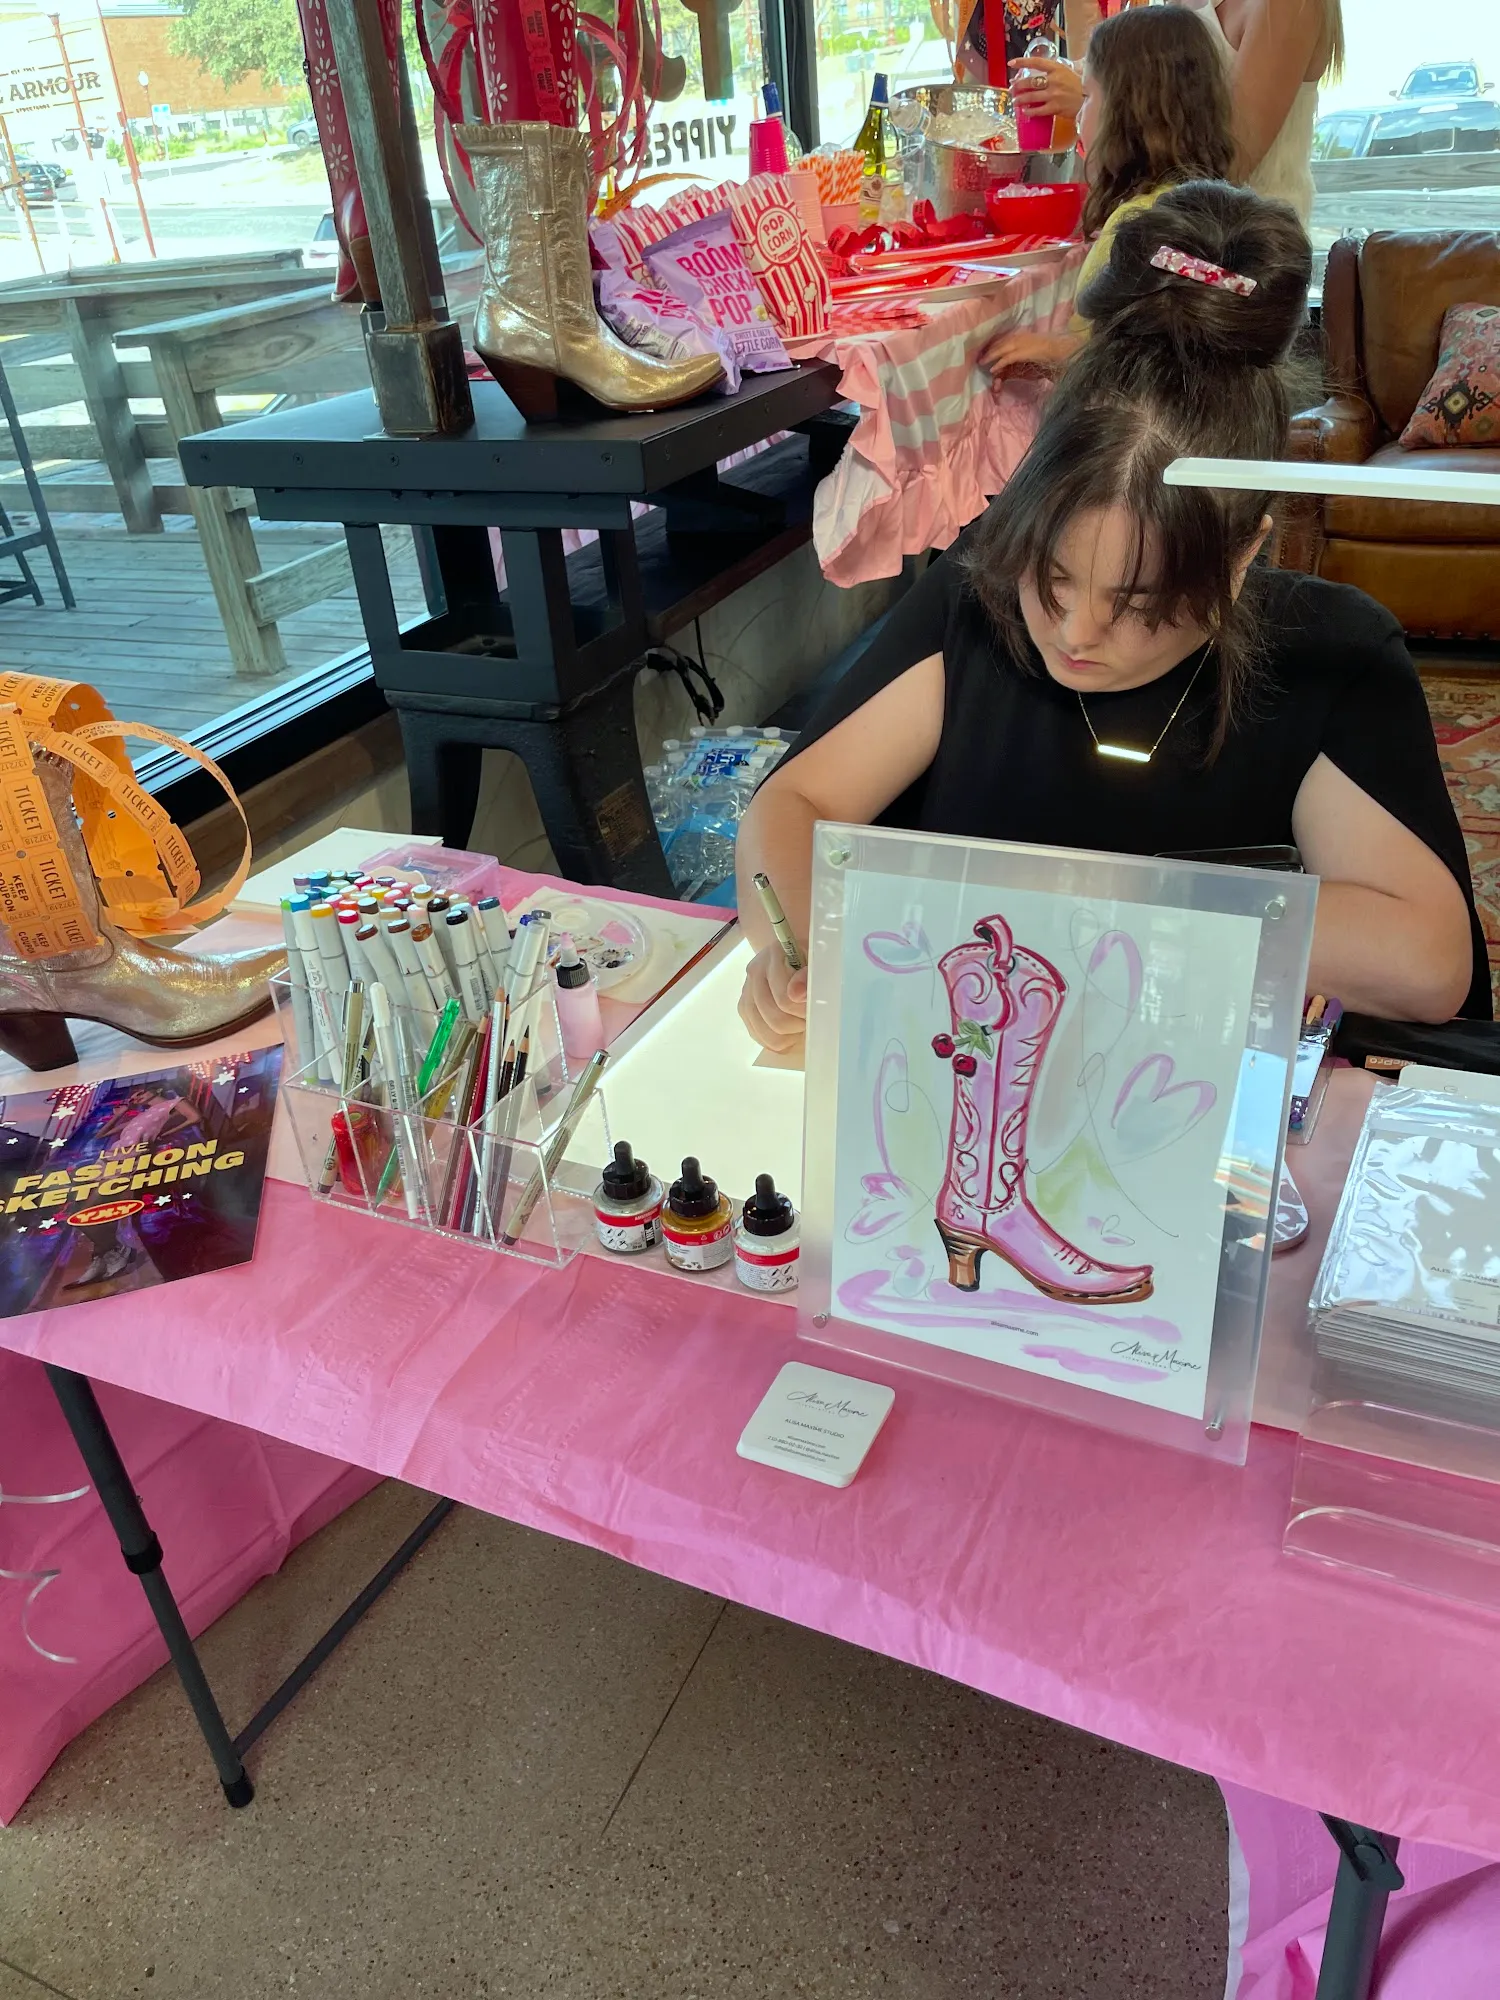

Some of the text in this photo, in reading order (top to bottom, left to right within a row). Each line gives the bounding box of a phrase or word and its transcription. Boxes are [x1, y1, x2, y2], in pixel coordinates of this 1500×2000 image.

[9, 71, 101, 102] ARMOUR
[762, 214, 786, 234] POP
[766, 227, 796, 252] CORN
[676, 242, 746, 279] BOOM
[698, 269, 757, 297] CHICKA
[708, 293, 753, 329] POP
[733, 336, 781, 354] ETTLE CORN
[42, 682, 64, 708] COUPO
[61, 739, 103, 770] TICKET
[14, 785, 43, 831] TICKET
[121, 784, 156, 820] TICKET
[24, 832, 53, 845] 137218
[165, 834, 186, 869] TICKET
[8, 882, 18, 899] THIS
[12, 874, 29, 901] KEEP
[39, 858, 67, 900] TICKET
[35, 932, 50, 948] KEEP
[62, 919, 86, 944] TICKET
[99, 1141, 150, 1159] LIVE
[13, 1138, 219, 1194] FASHION
[785, 1418, 844, 1438] ALISA MAXIME STUDIO
